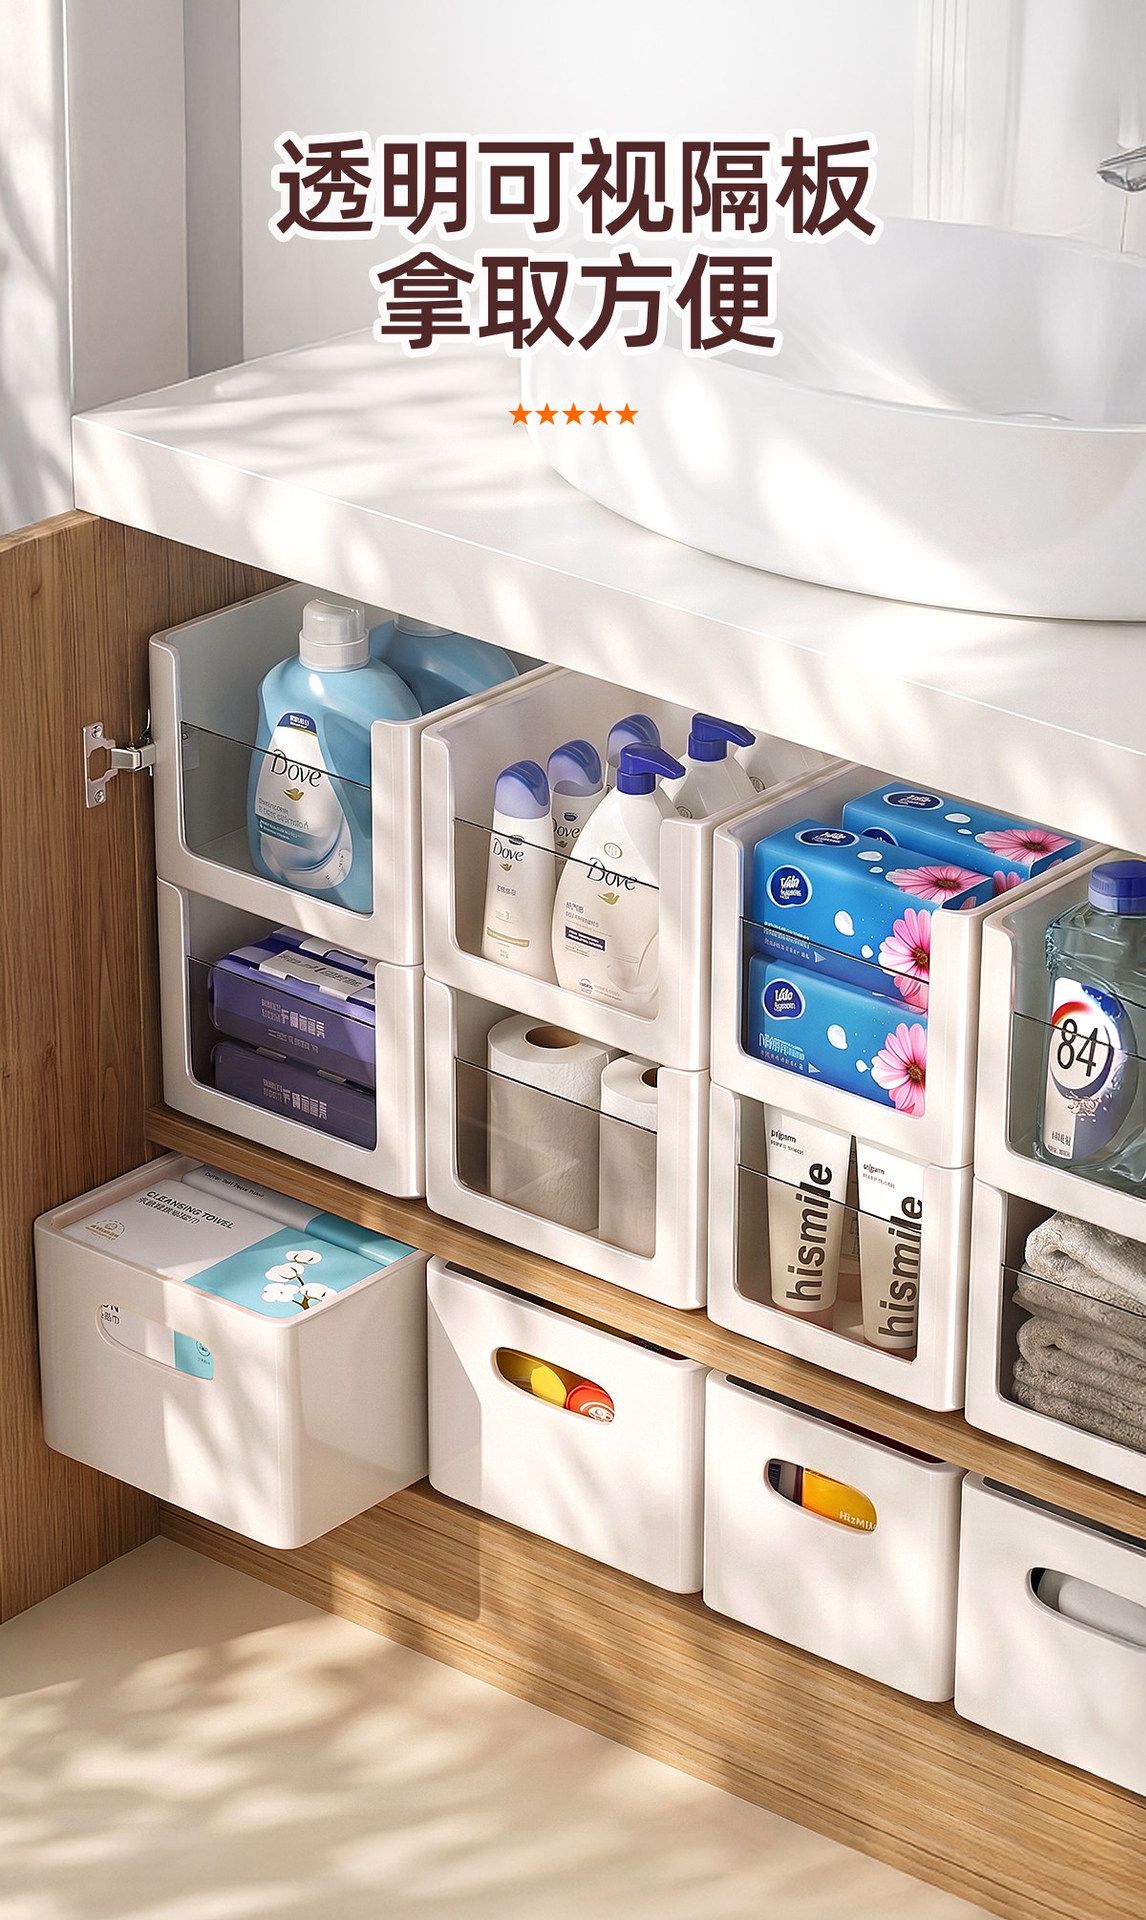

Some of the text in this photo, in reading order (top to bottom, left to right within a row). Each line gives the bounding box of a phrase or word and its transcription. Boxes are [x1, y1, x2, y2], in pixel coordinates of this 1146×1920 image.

[271, 748, 321, 788] Dove
[493, 837, 524, 862] Dove
[586, 856, 638, 891] Dove
[1057, 1018, 1097, 1078] 84
[146, 1190, 202, 1217] CLEANSING
[201, 1211, 235, 1230] TOWEL
[785, 1162, 833, 1302] hismile
[878, 1195, 923, 1338] hismile
